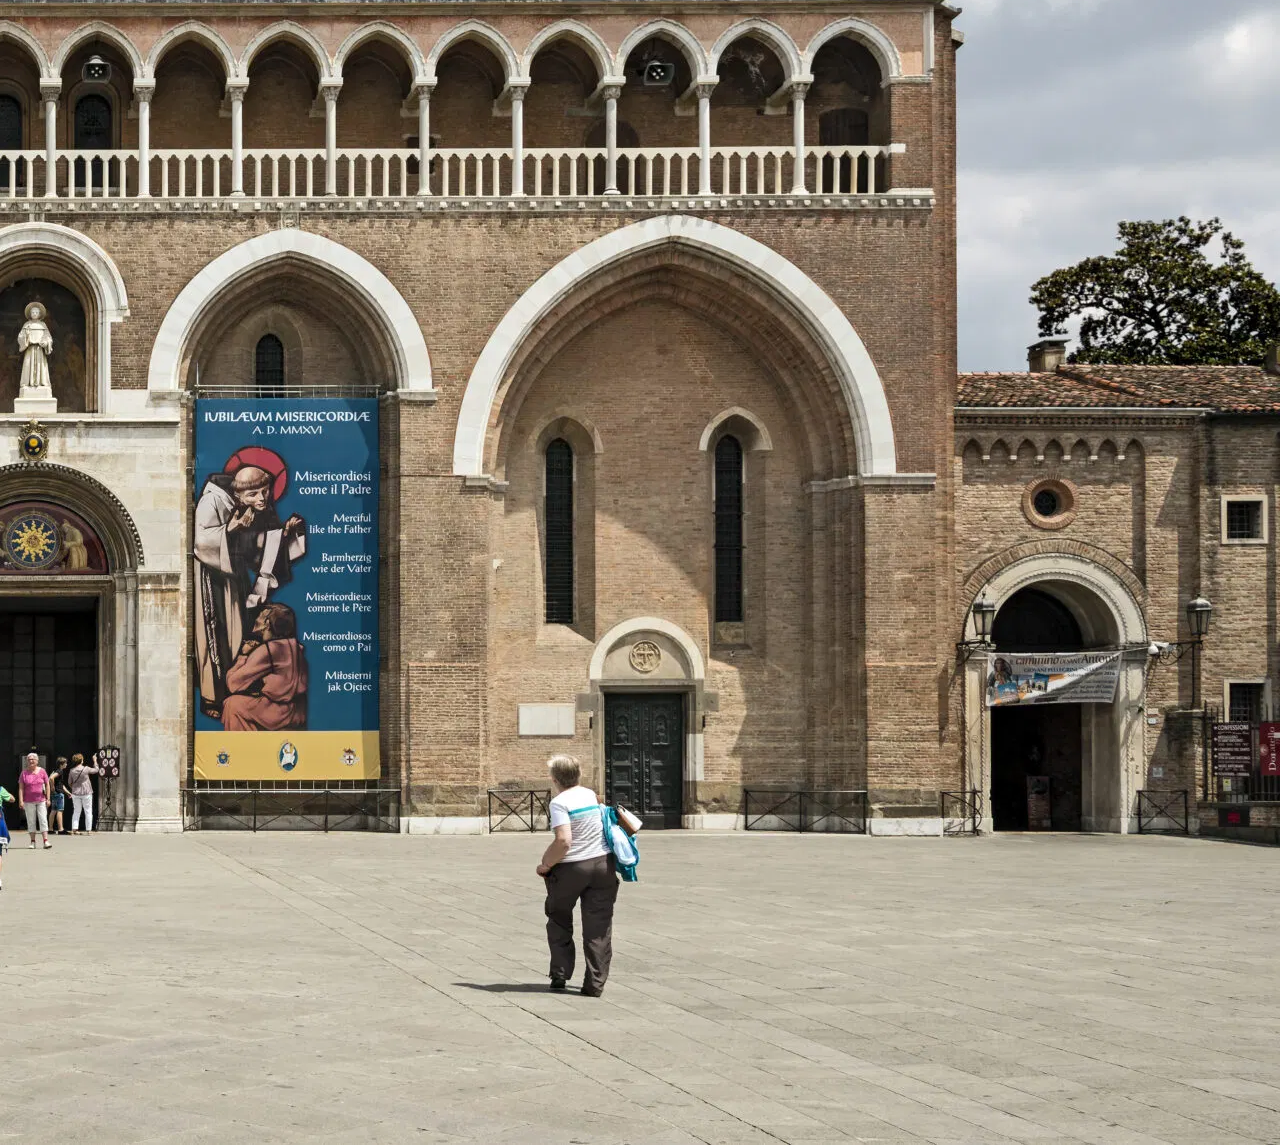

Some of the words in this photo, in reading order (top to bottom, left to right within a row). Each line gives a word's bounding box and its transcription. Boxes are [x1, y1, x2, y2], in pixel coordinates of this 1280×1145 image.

[205, 411, 272, 422] IUBILÆUM
[275, 411, 370, 422] MISERICORDIÆ
[252, 425, 264, 434] A.
[267, 425, 277, 434] D.
[280, 425, 322, 434] MMXVI
[295, 471, 371, 482] Misericordiosi
[299, 486, 327, 495] come
[331, 484, 337, 495] il
[342, 484, 371, 495] Padre
[333, 513, 371, 523] Merciful
[309, 525, 325, 534] like
[328, 525, 341, 534] the
[344, 525, 371, 534] Father
[322, 553, 371, 563] Barmherzig
[312, 564, 328, 573] wie
[331, 563, 345, 573] der
[347, 563, 371, 573] Vater
[306, 592, 371, 602] Miséricordieux
[308, 605, 339, 613] comme
[342, 603, 349, 613] le
[353, 603, 371, 613] Père
[303, 632, 371, 641] Misericordiosos
[323, 644, 346, 652] como
[349, 644, 354, 652] o
[358, 643, 371, 652] Pai
[325, 671, 371, 680] Miłosierni
[328, 682, 341, 693] jak
[344, 682, 371, 693] Ojciec
